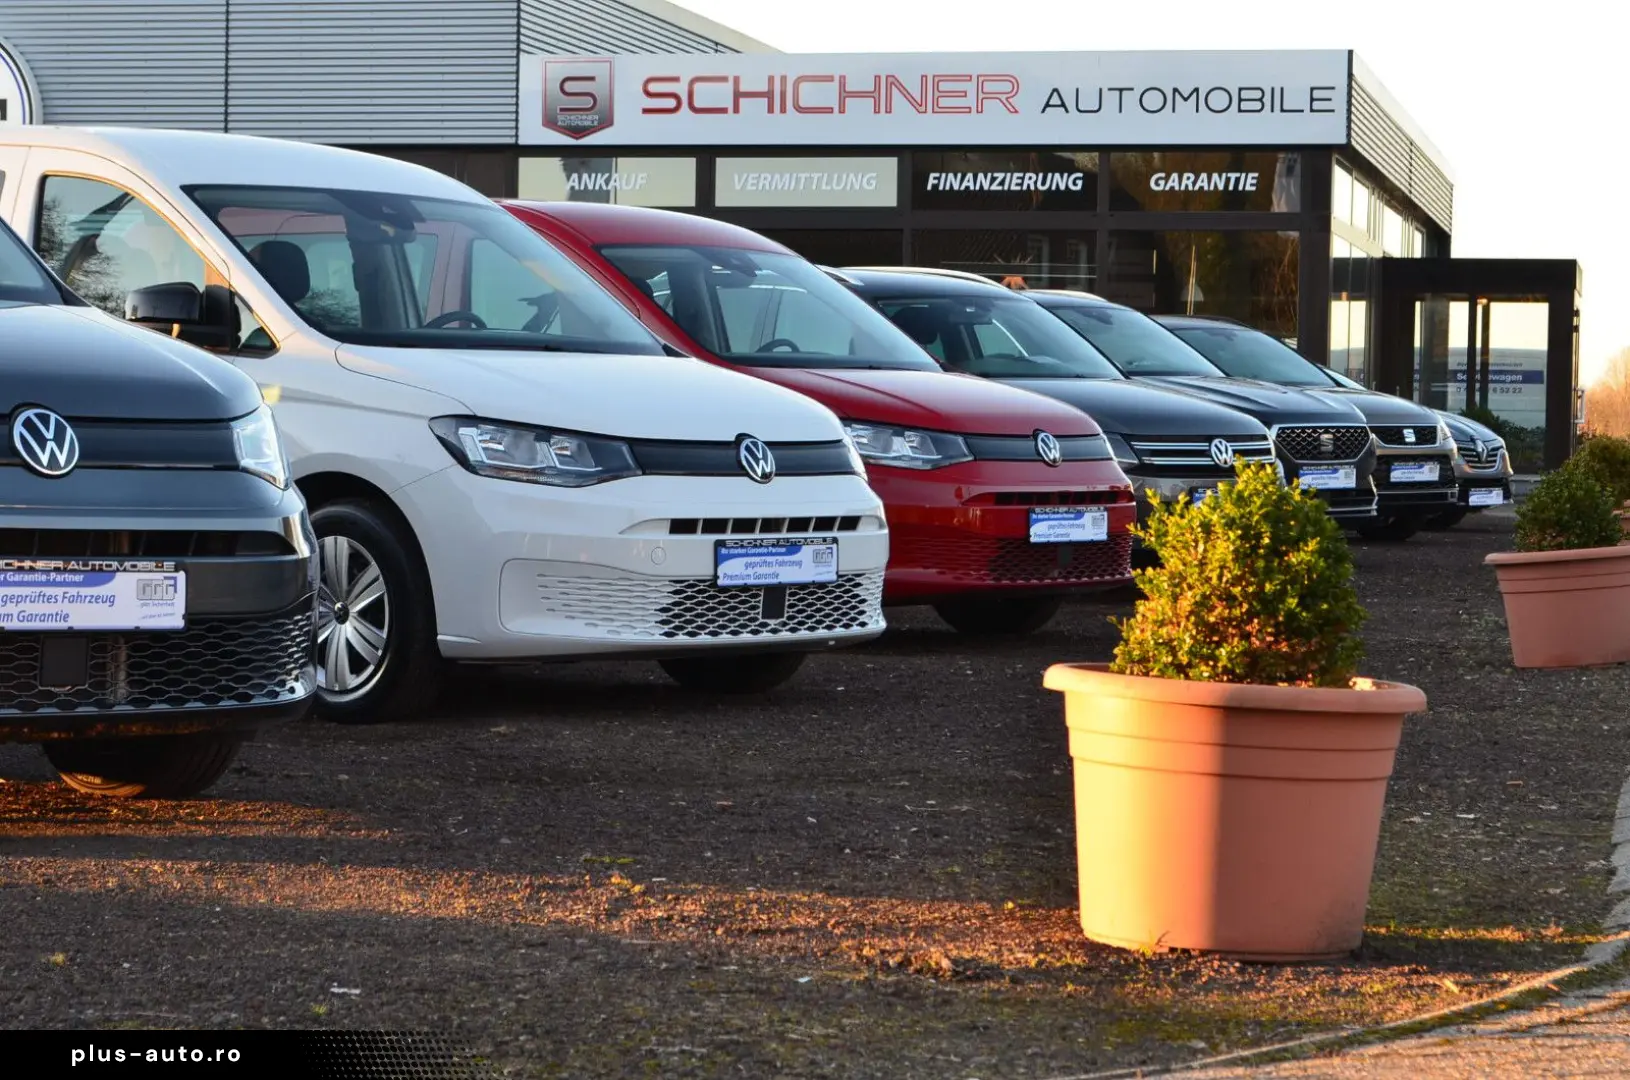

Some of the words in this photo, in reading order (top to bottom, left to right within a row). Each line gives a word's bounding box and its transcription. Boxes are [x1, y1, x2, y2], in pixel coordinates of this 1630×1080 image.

[641, 74, 1020, 115] SCHICHNER
[1041, 86, 1336, 114] AUTOMOBILE
[566, 172, 648, 191] ANKAUF
[733, 172, 878, 191] VERMITTLUNG
[927, 172, 1084, 191] FINANZIERUNG
[1149, 172, 1259, 191] GARANTIE
[779, 538, 833, 546] AUTOMOBILE
[0, 560, 64, 571] ICHNER
[67, 561, 176, 572] AUTOMOBILE
[774, 558, 803, 569] Fahrzeug
[6, 572, 84, 582] Garantie-Partner
[722, 572, 752, 581] Premium
[752, 571, 780, 581] Garantie
[0, 590, 59, 608] geprüftes
[61, 590, 116, 608] Fahrzeug
[17, 609, 70, 623] Garantie
